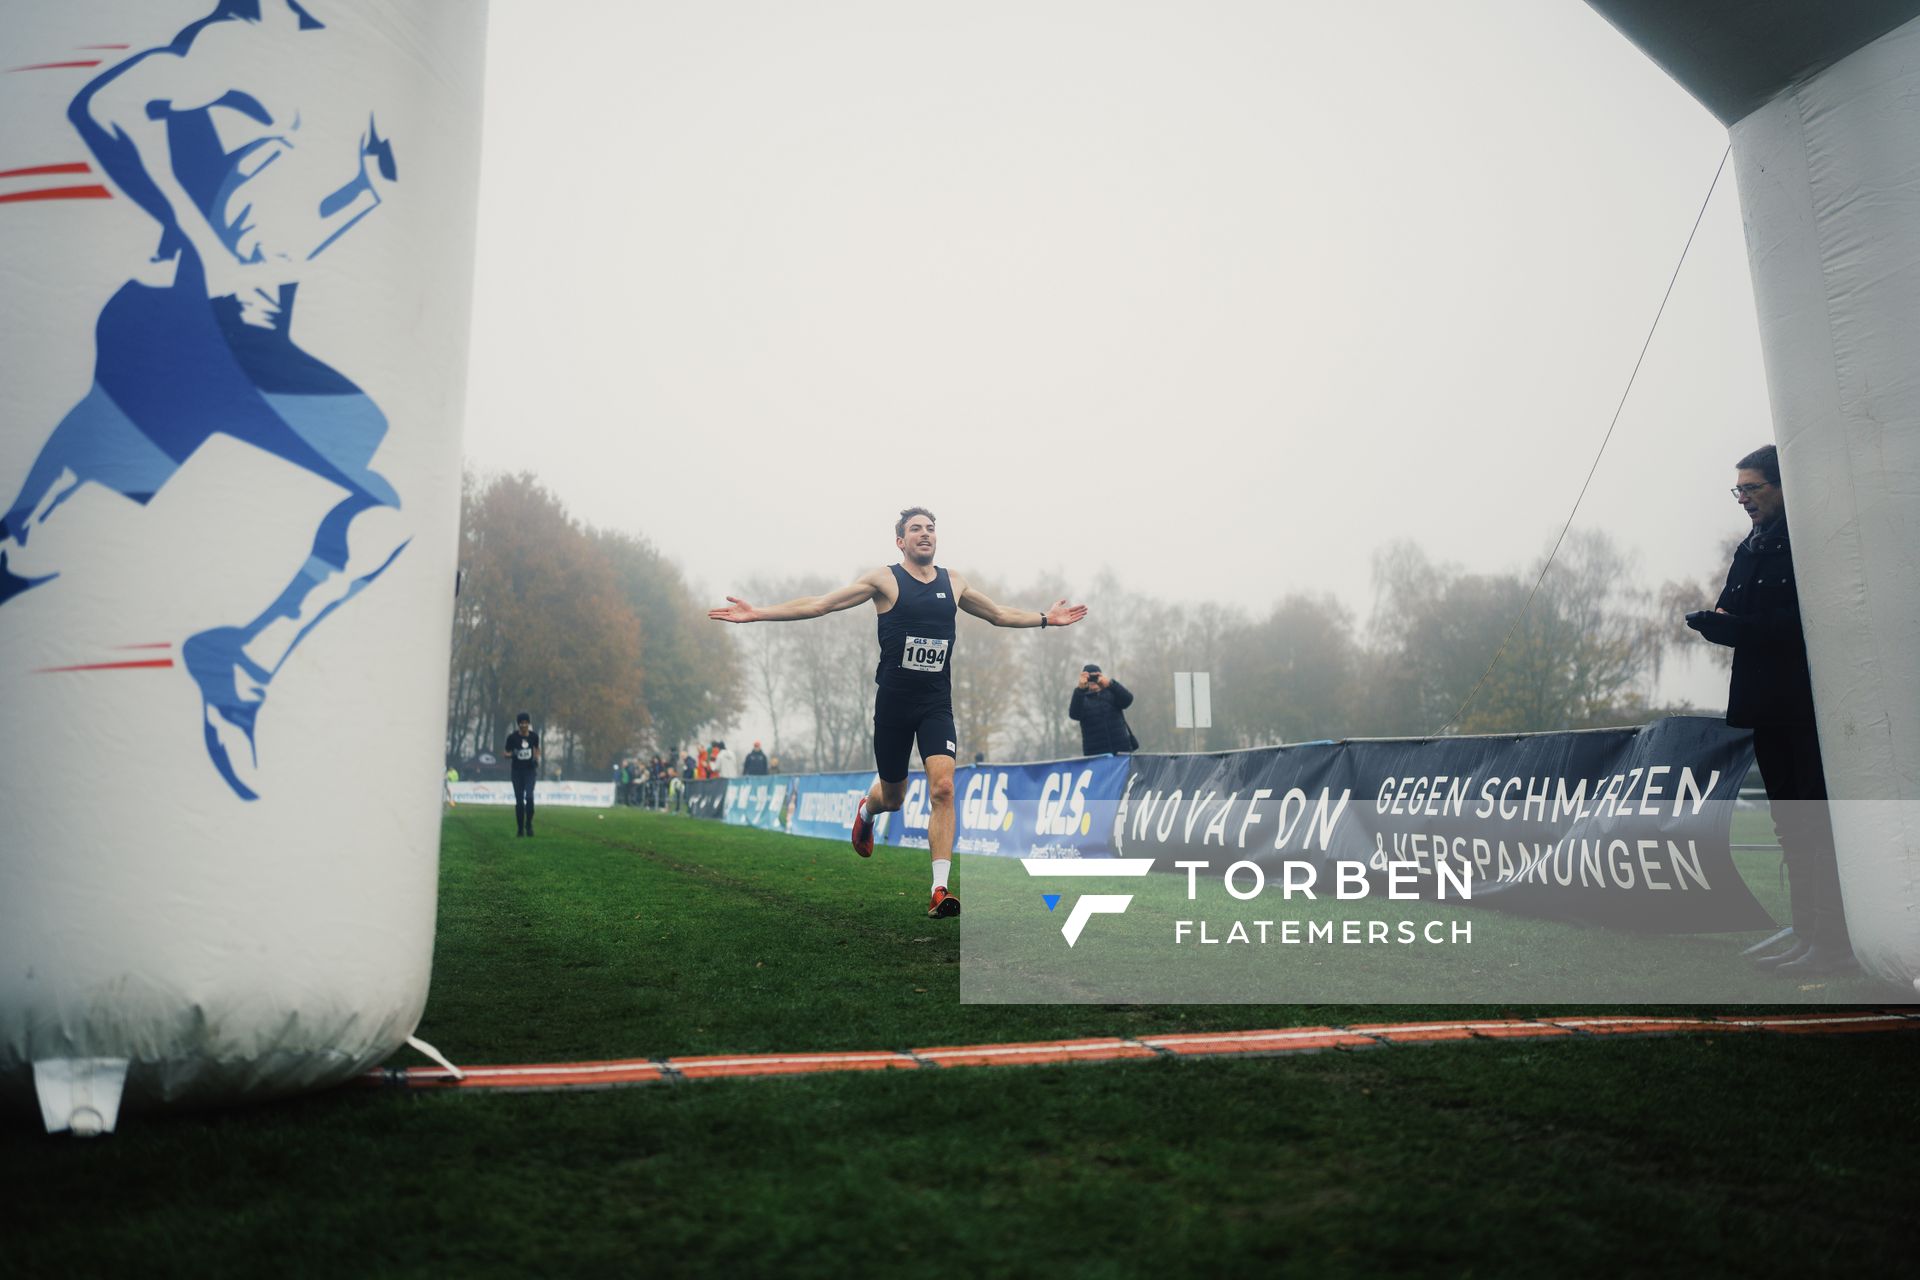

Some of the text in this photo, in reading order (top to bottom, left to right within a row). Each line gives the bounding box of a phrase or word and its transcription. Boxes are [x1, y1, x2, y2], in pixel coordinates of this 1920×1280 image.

[906, 646, 945, 665] 1094
[903, 779, 932, 830] GL
[1376, 776, 1471, 816] GEGEN
[1132, 787, 1351, 850] NOVAFON
[1369, 832, 1388, 871] &
